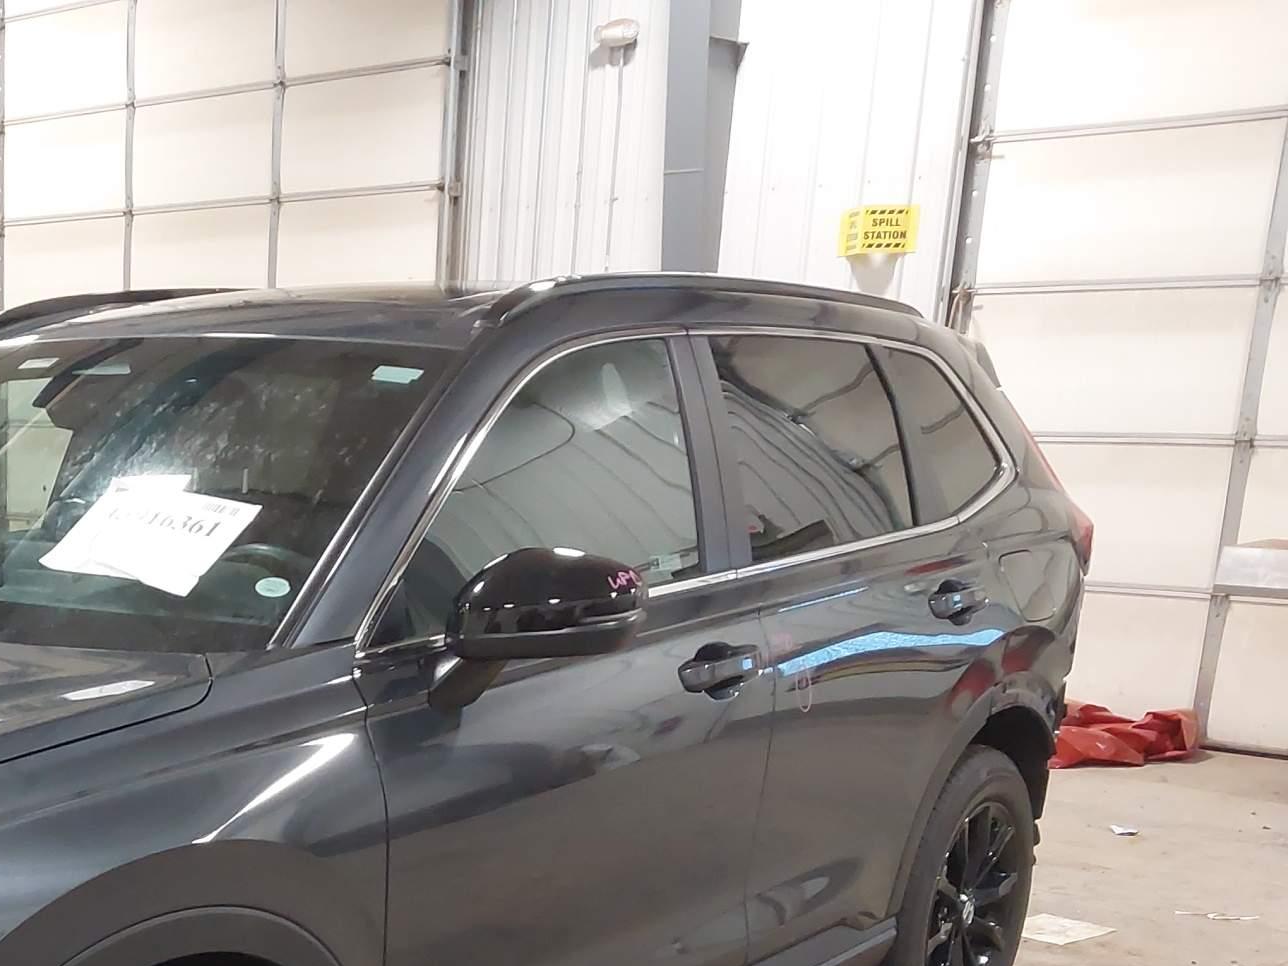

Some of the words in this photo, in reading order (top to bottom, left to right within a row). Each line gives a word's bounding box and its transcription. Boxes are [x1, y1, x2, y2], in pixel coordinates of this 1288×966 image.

[871, 217, 901, 227] SPILL
[863, 230, 907, 240] STATION
[108, 508, 221, 536] 16361
